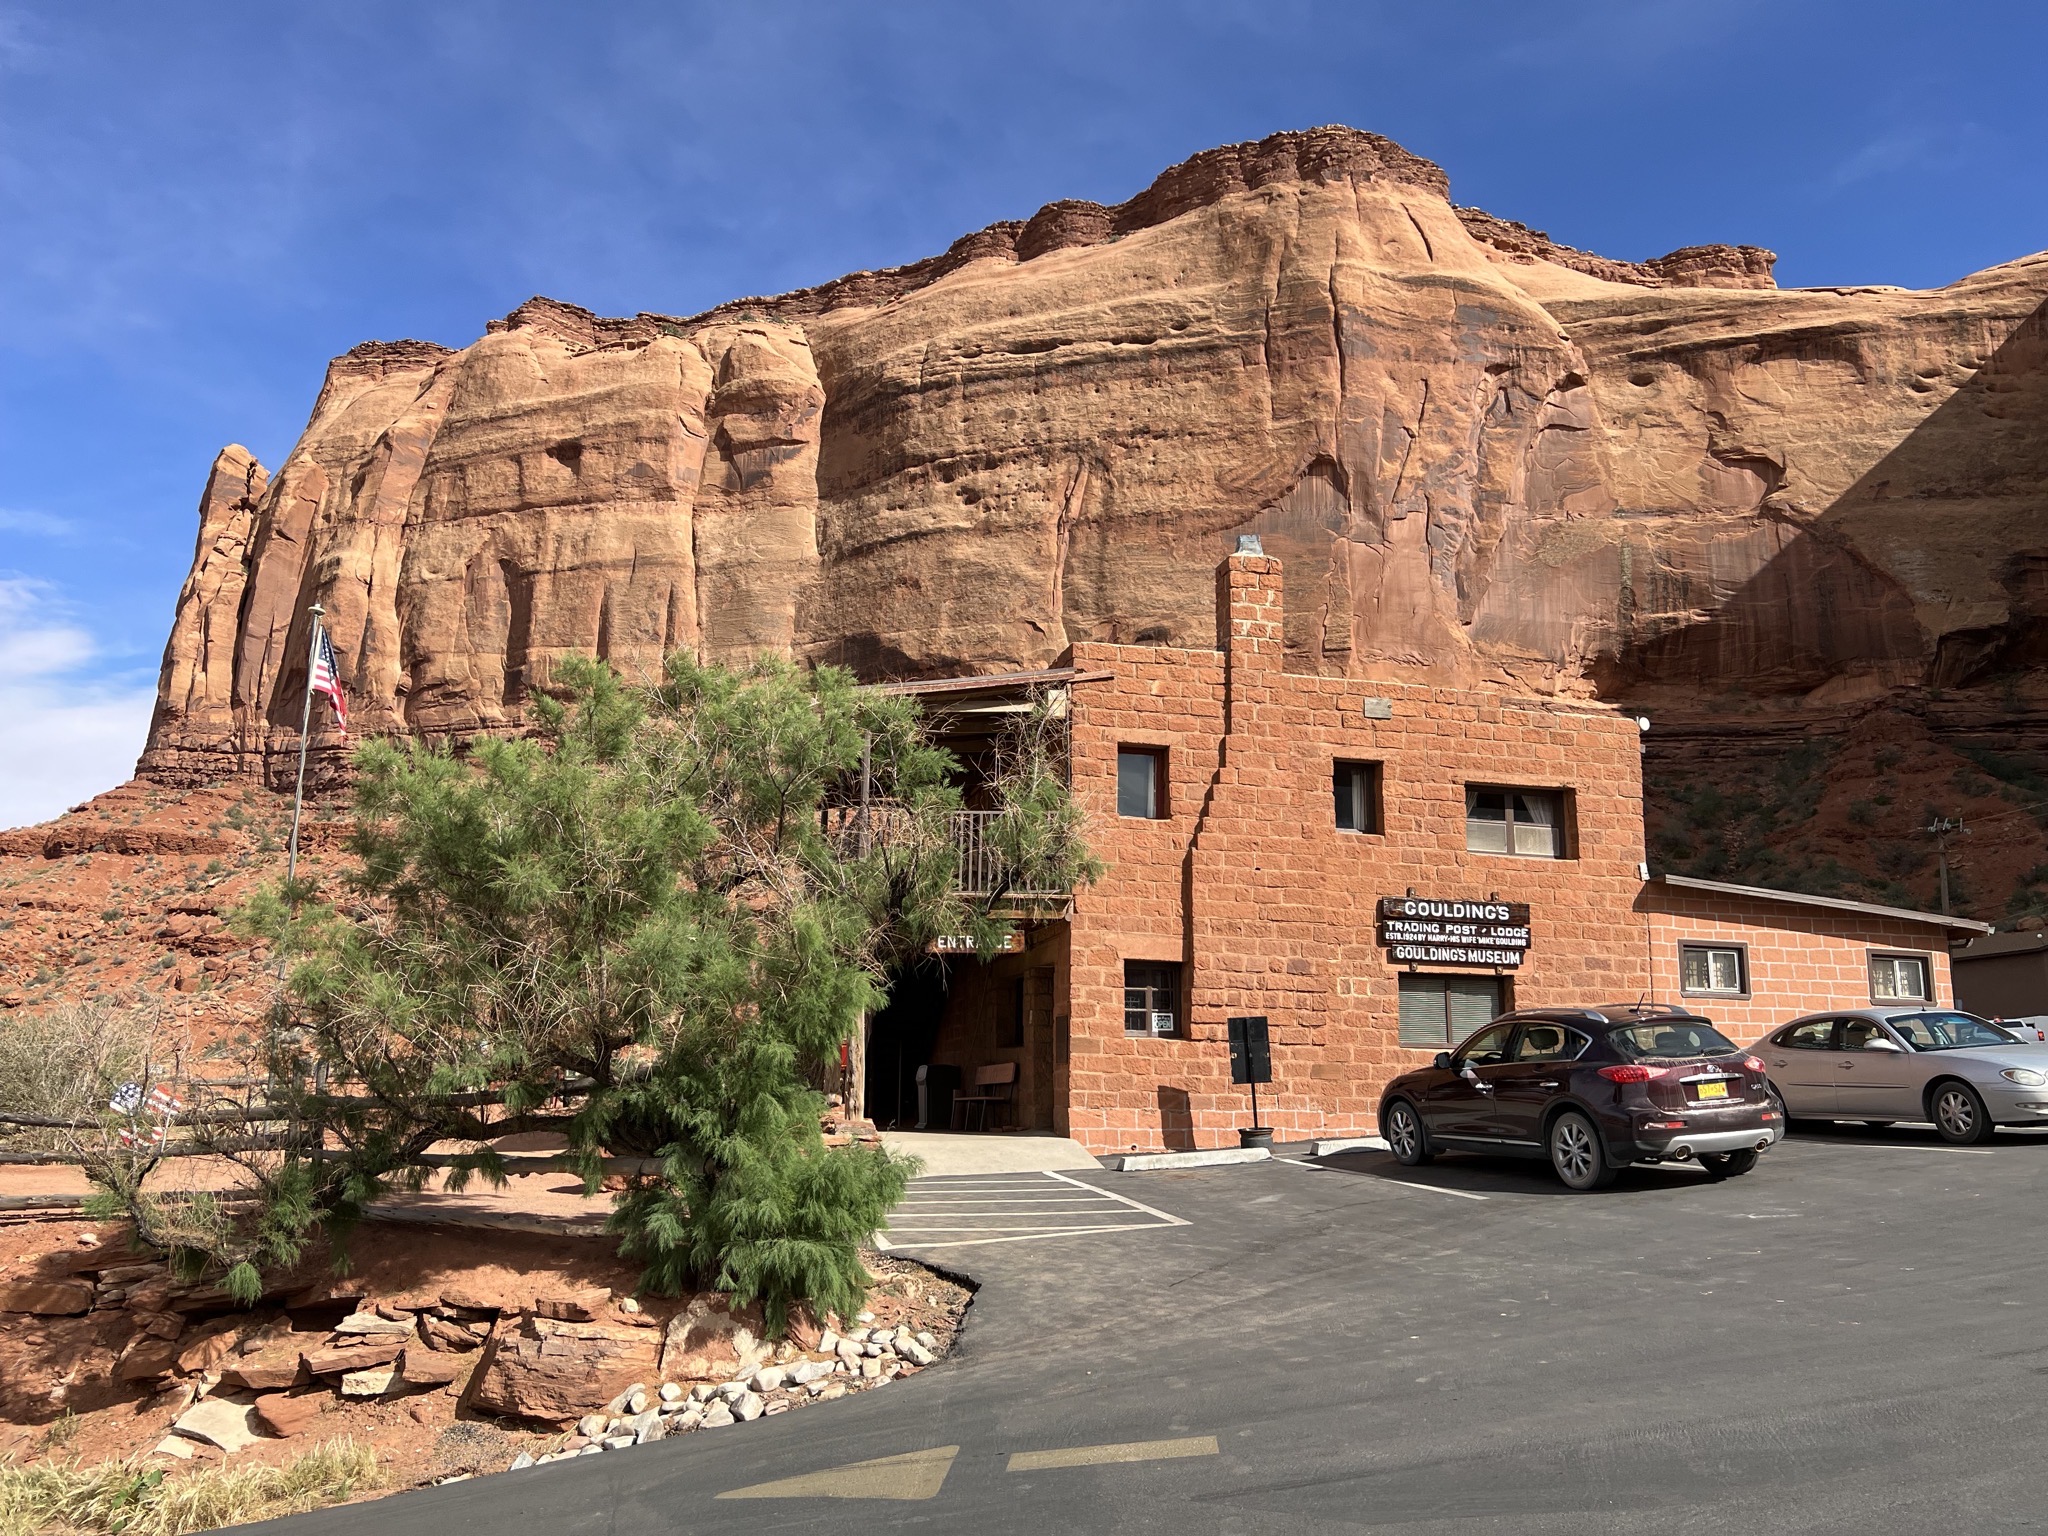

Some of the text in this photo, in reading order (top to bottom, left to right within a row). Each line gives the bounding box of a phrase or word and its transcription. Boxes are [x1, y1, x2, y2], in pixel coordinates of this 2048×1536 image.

[1405, 901, 1510, 920] GOULDING'S
[1386, 921, 1529, 938] TRADING POST LODGE
[937, 935, 1013, 949] ENTRE
[1461, 935, 1477, 944] WIFE
[1495, 937, 1527, 946] GOULDING
[1396, 946, 1521, 965] GOULDING'S MUSEUM
